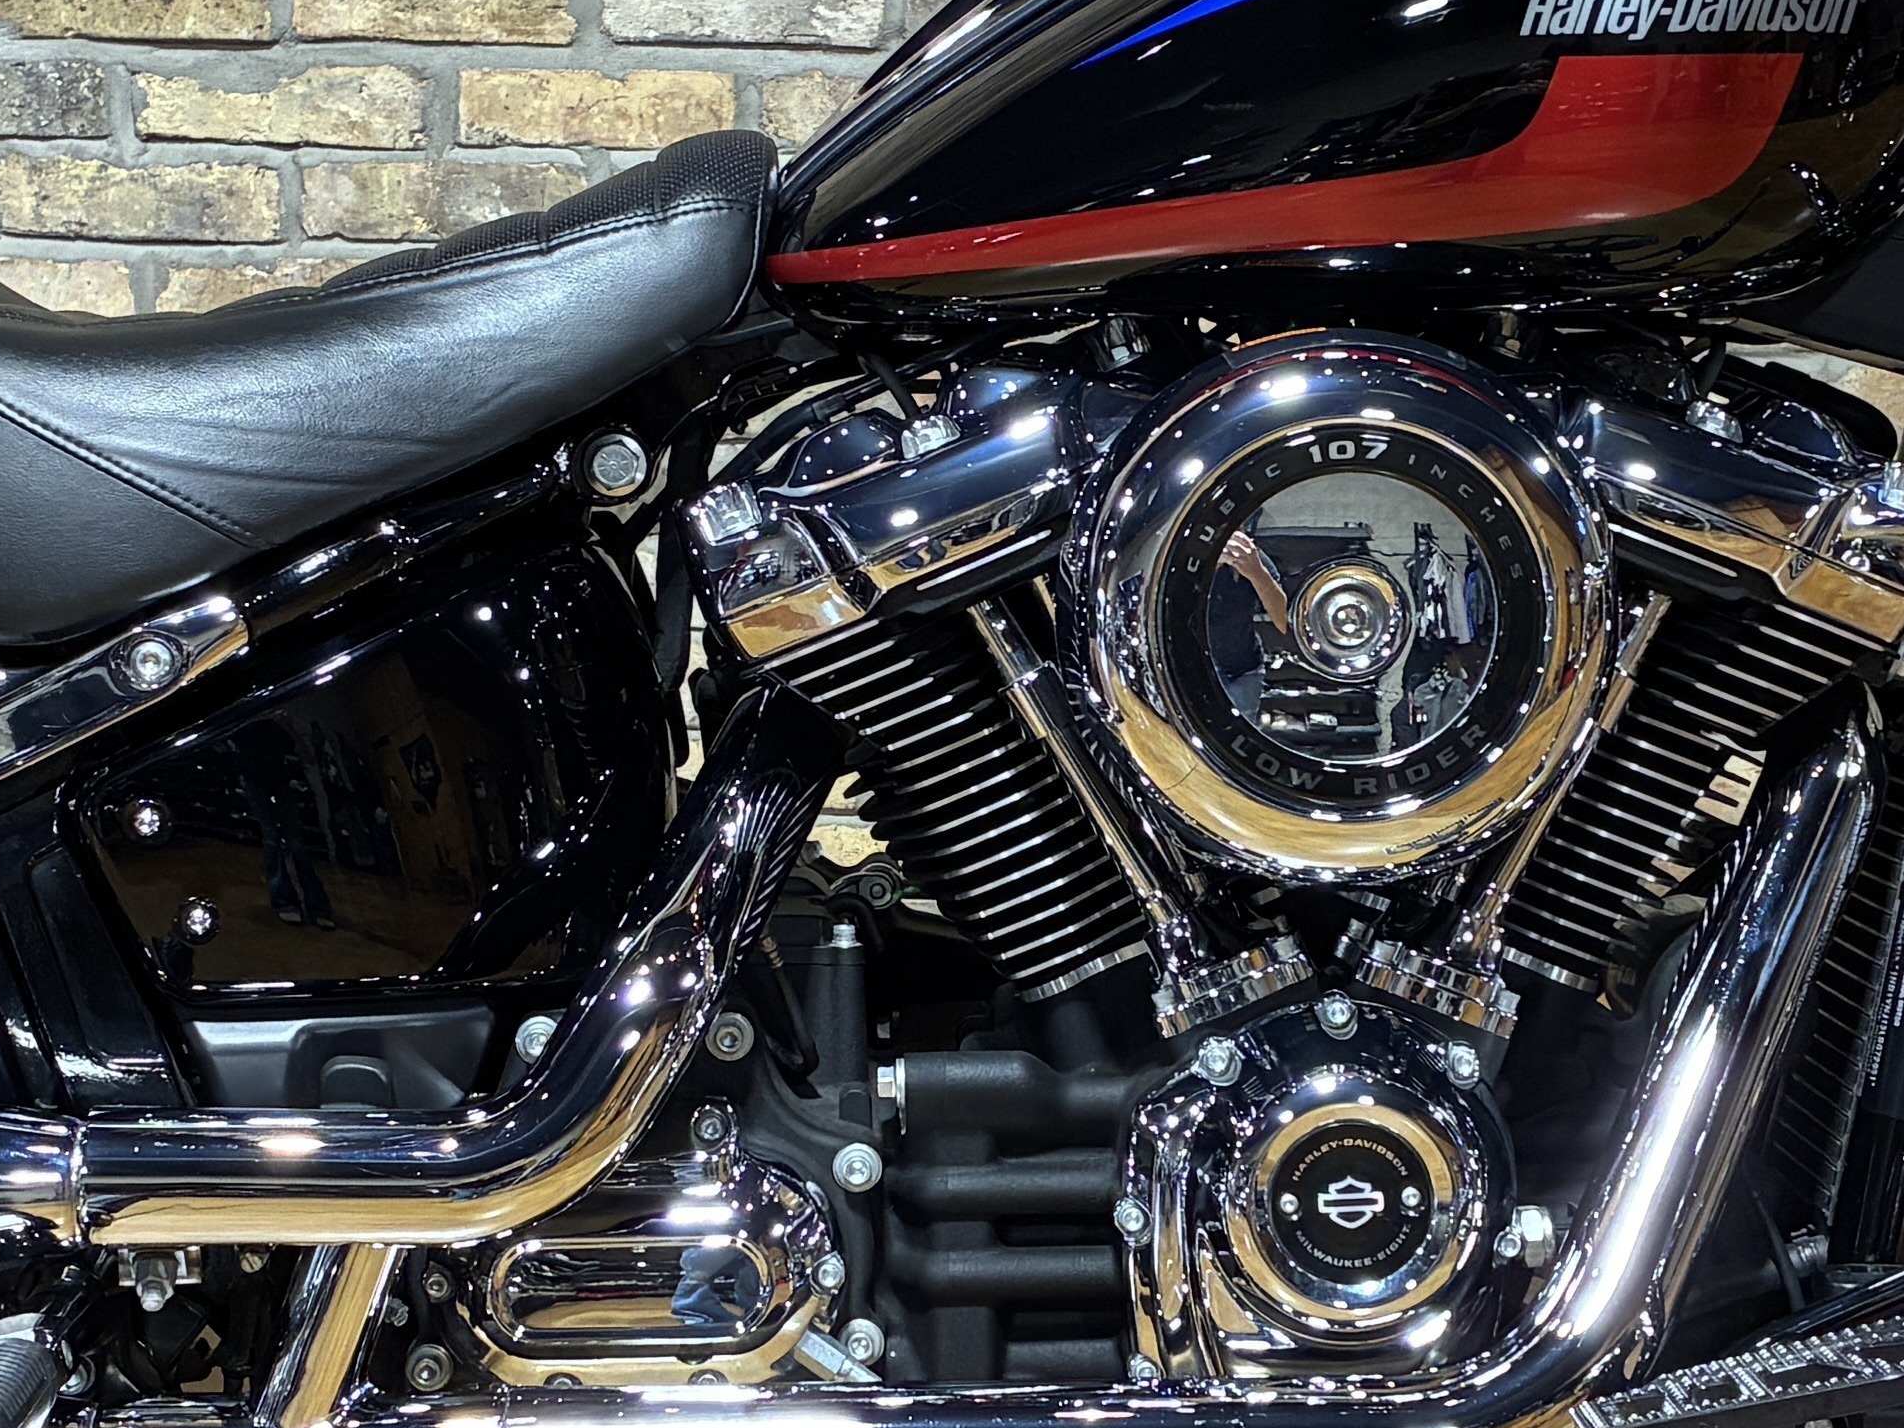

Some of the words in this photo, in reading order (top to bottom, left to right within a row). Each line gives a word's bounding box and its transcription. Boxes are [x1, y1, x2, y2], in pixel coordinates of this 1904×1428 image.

[1185, 464, 1283, 575] CUBIC
[1307, 439, 1392, 464] 107
[1407, 453, 1524, 582] INCHES
[1229, 733, 1324, 791] LOW
[1353, 722, 1488, 796] RIDER
